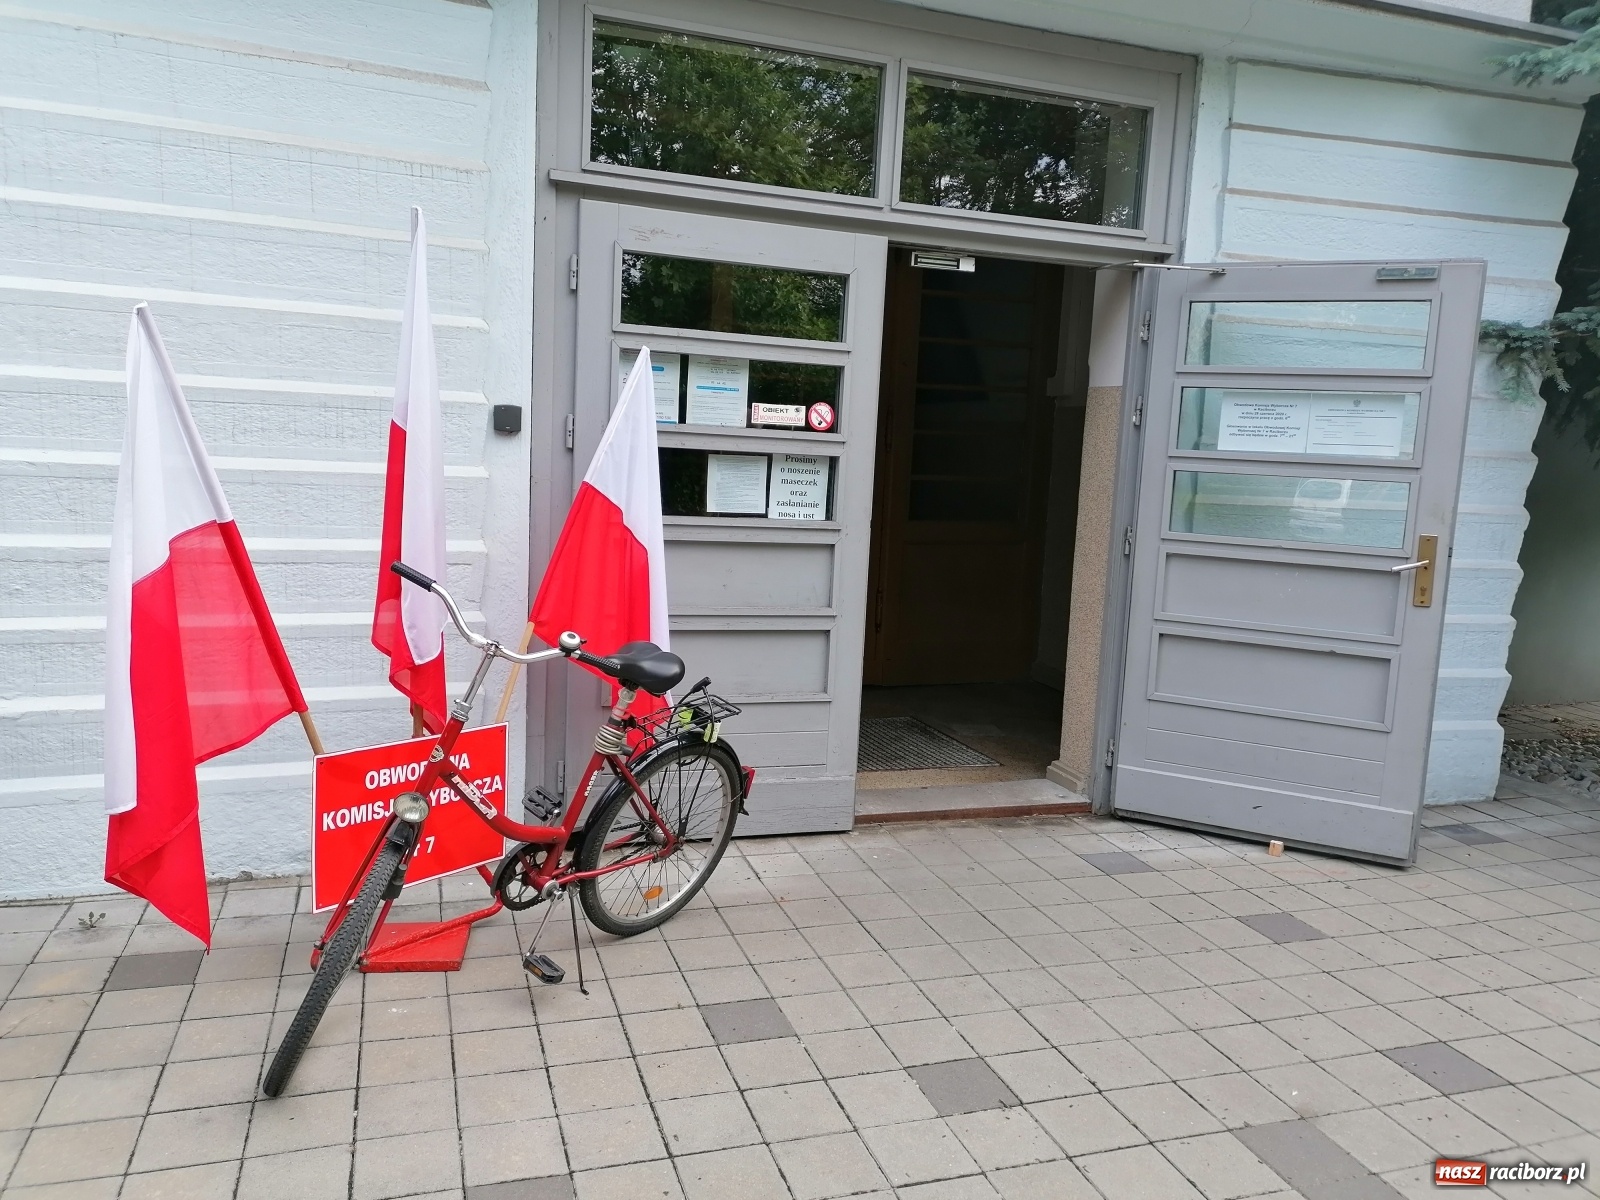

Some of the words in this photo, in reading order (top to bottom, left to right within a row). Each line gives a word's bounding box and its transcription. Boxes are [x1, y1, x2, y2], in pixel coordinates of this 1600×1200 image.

[762, 406, 790, 414] OBIEKT
[759, 414, 804, 423] MONITOROWANY
[785, 454, 818, 466] Prosimy
[787, 466, 821, 476] noszenie
[780, 478, 818, 487] maseczek
[789, 489, 808, 497] oraz
[776, 499, 820, 509] zasłanianie
[365, 753, 470, 790] OBWOA
[322, 797, 396, 831] KOMISJ
[428, 775, 503, 807] YBOCZA
[425, 836, 436, 854] 7
